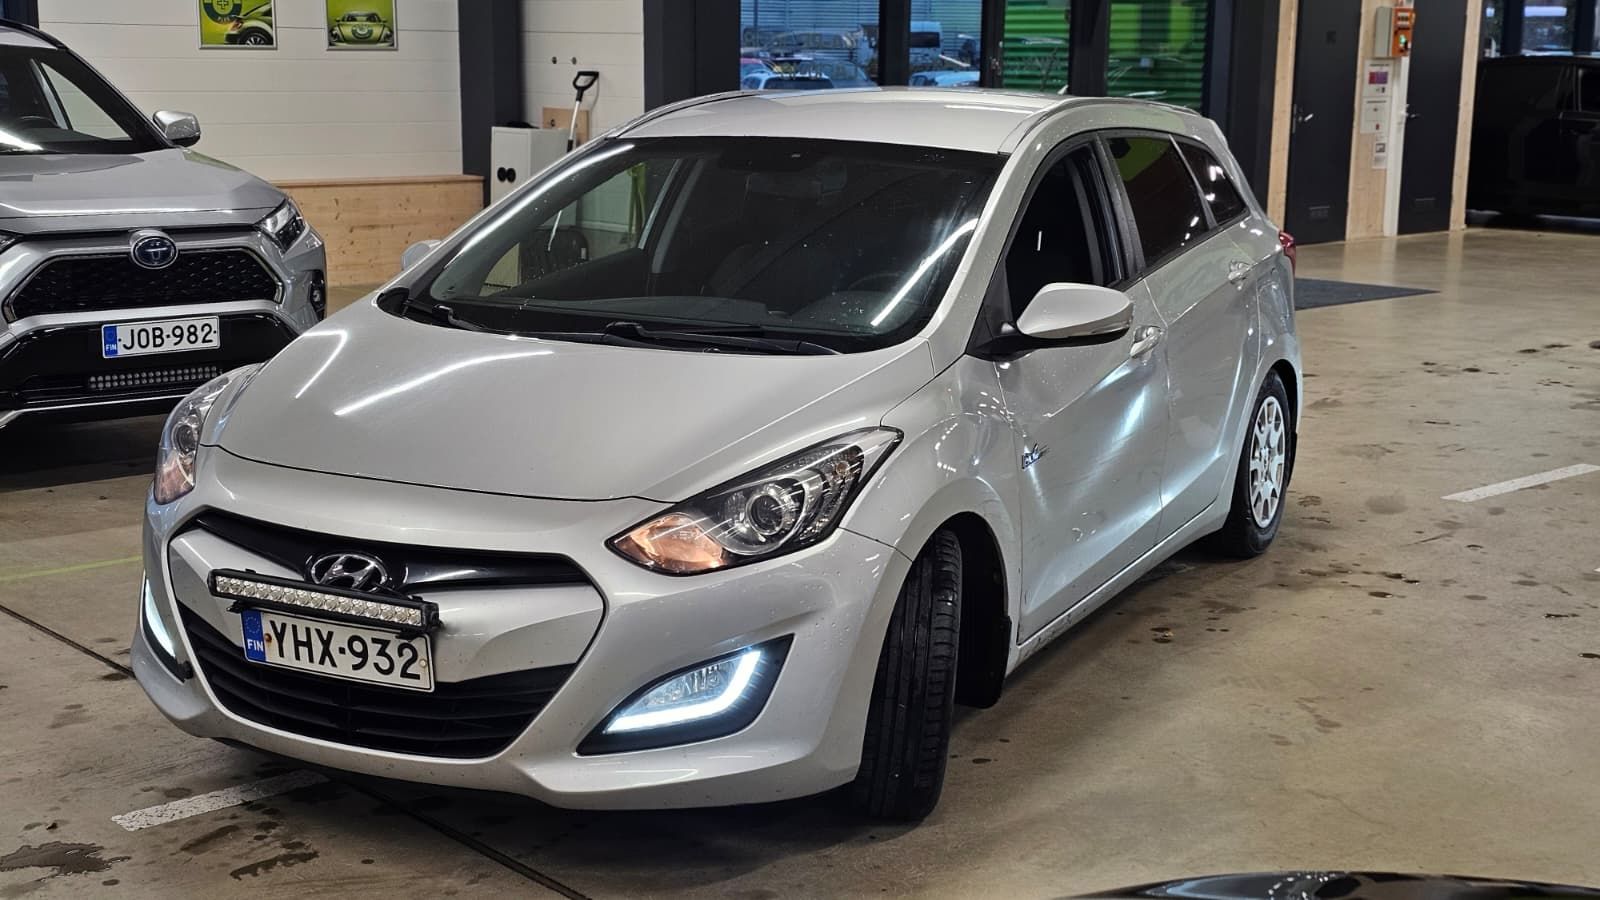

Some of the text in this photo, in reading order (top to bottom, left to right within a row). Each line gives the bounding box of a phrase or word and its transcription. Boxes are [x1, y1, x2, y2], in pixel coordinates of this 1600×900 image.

[122, 323, 213, 350] JOB-982
[105, 343, 117, 352] FIN
[247, 638, 264, 652] FIN
[269, 620, 421, 680] YHX-932
